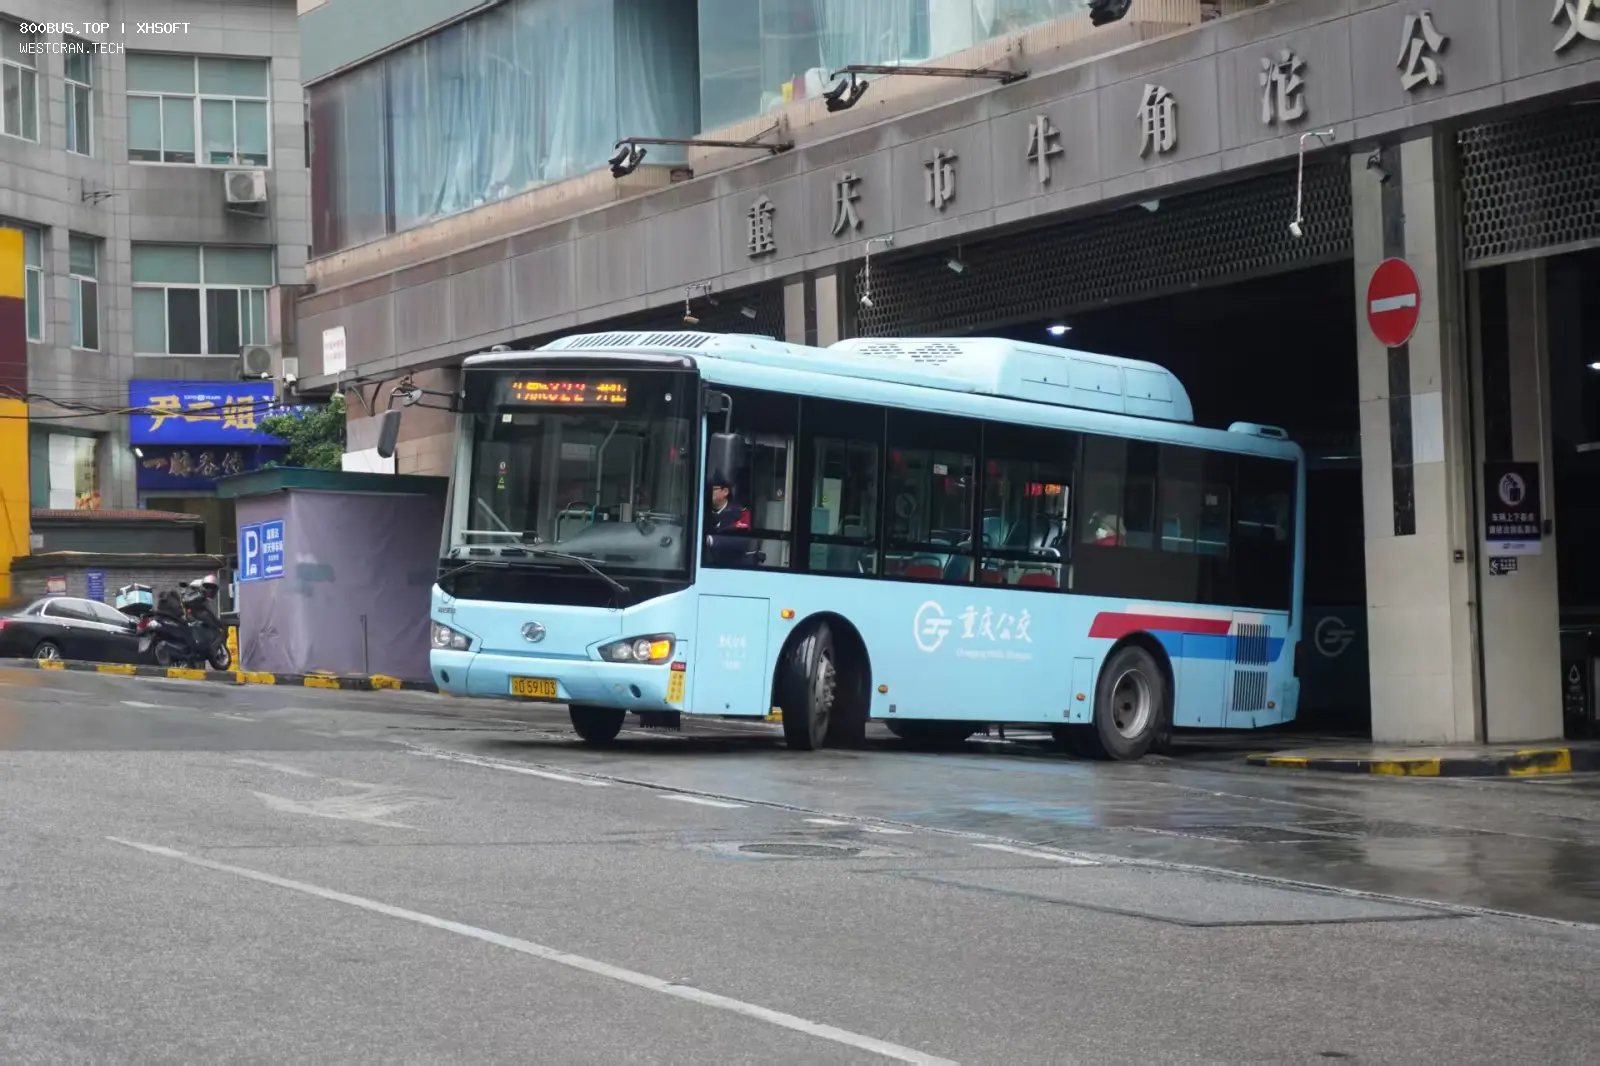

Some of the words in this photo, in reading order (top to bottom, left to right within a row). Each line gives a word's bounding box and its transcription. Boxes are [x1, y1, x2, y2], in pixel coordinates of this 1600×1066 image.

[148, 394, 257, 432] 尹二姐
[245, 530, 259, 577] P
[527, 680, 556, 695] 59103
